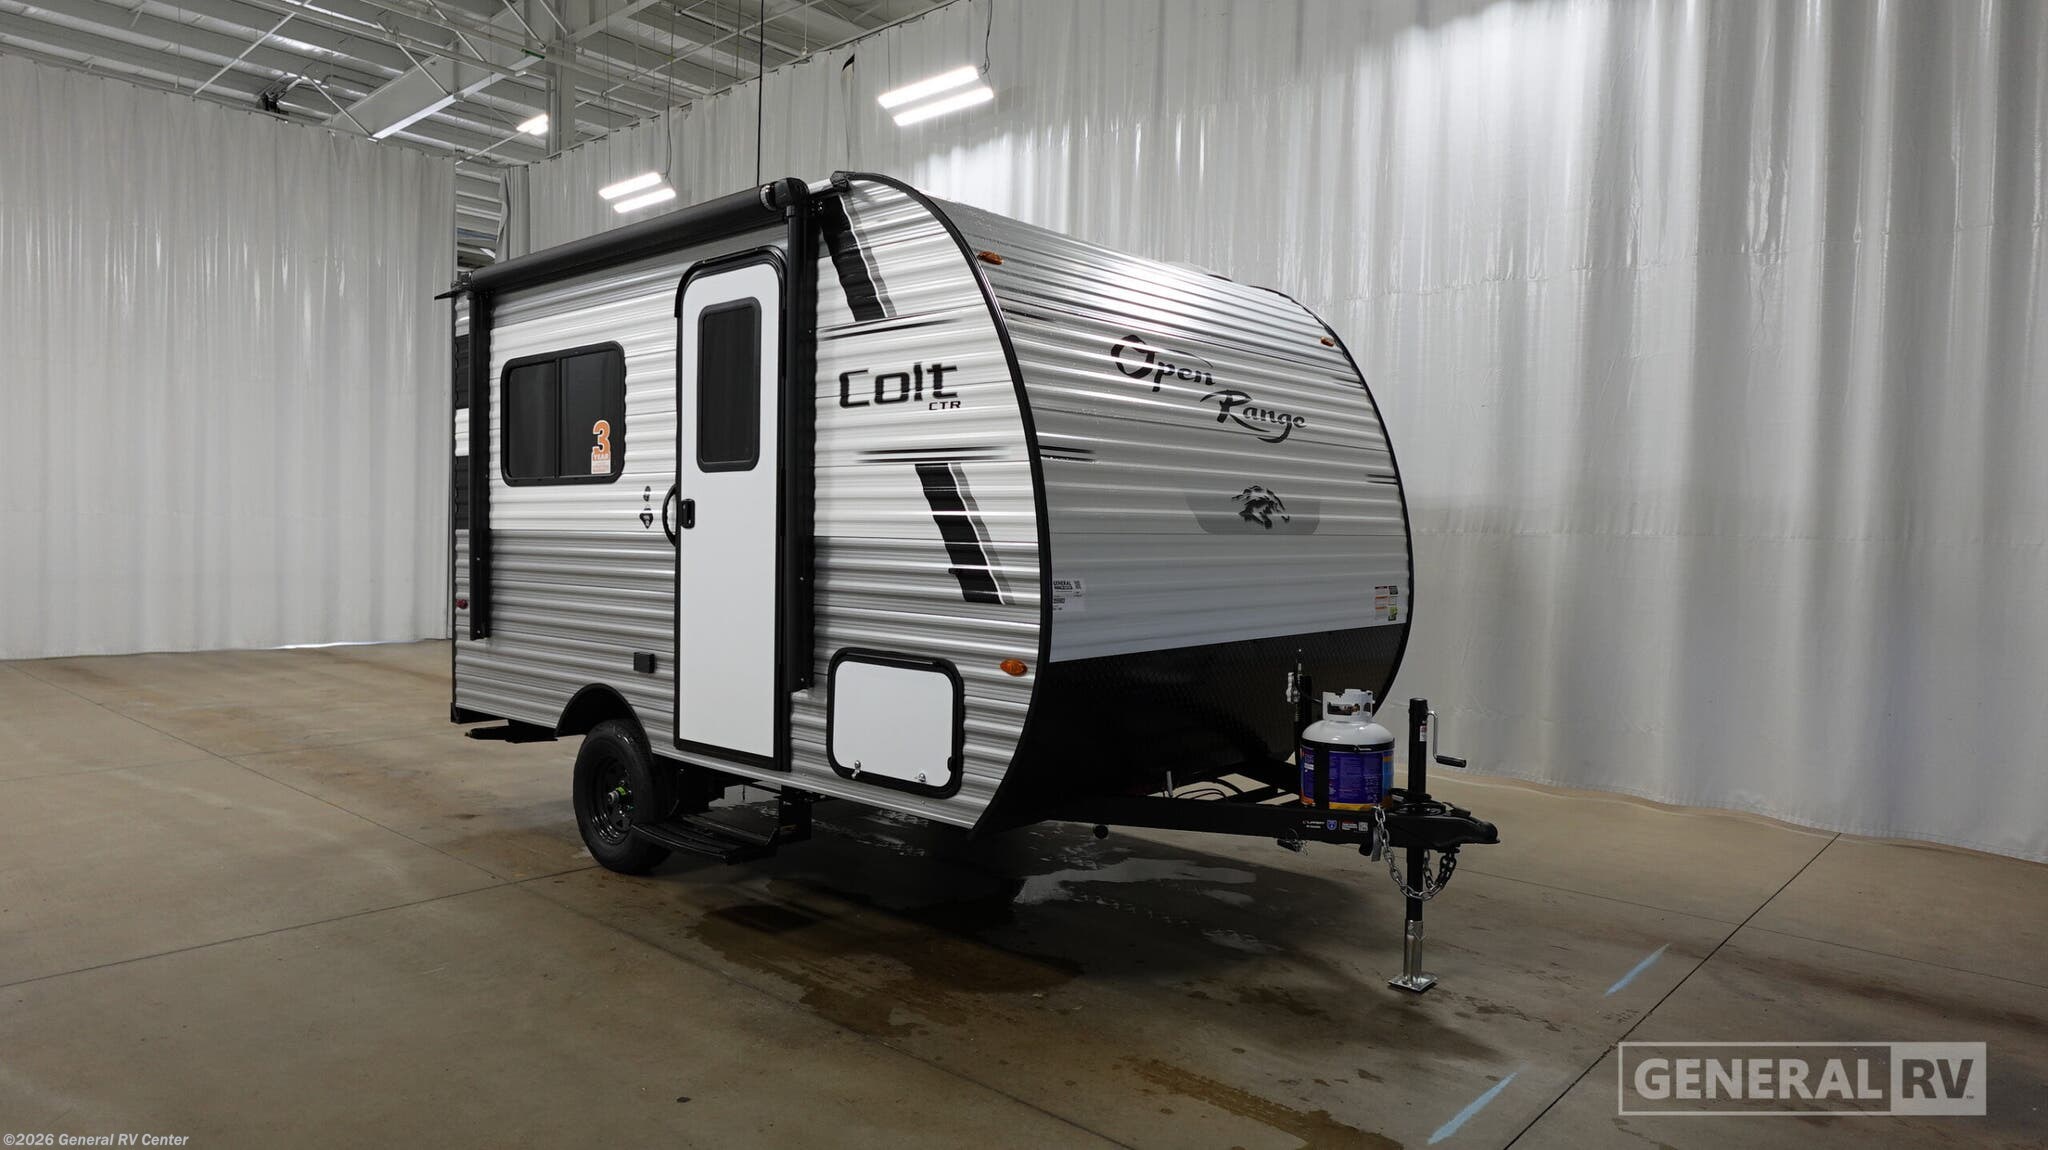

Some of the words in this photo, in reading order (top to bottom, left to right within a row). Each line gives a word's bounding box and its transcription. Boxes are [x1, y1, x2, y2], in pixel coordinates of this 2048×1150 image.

[839, 362, 957, 408] Colt
[1111, 335, 1215, 392] Open
[928, 401, 961, 411] CTR
[1200, 390, 1308, 443] Range
[593, 420, 610, 454] 3
